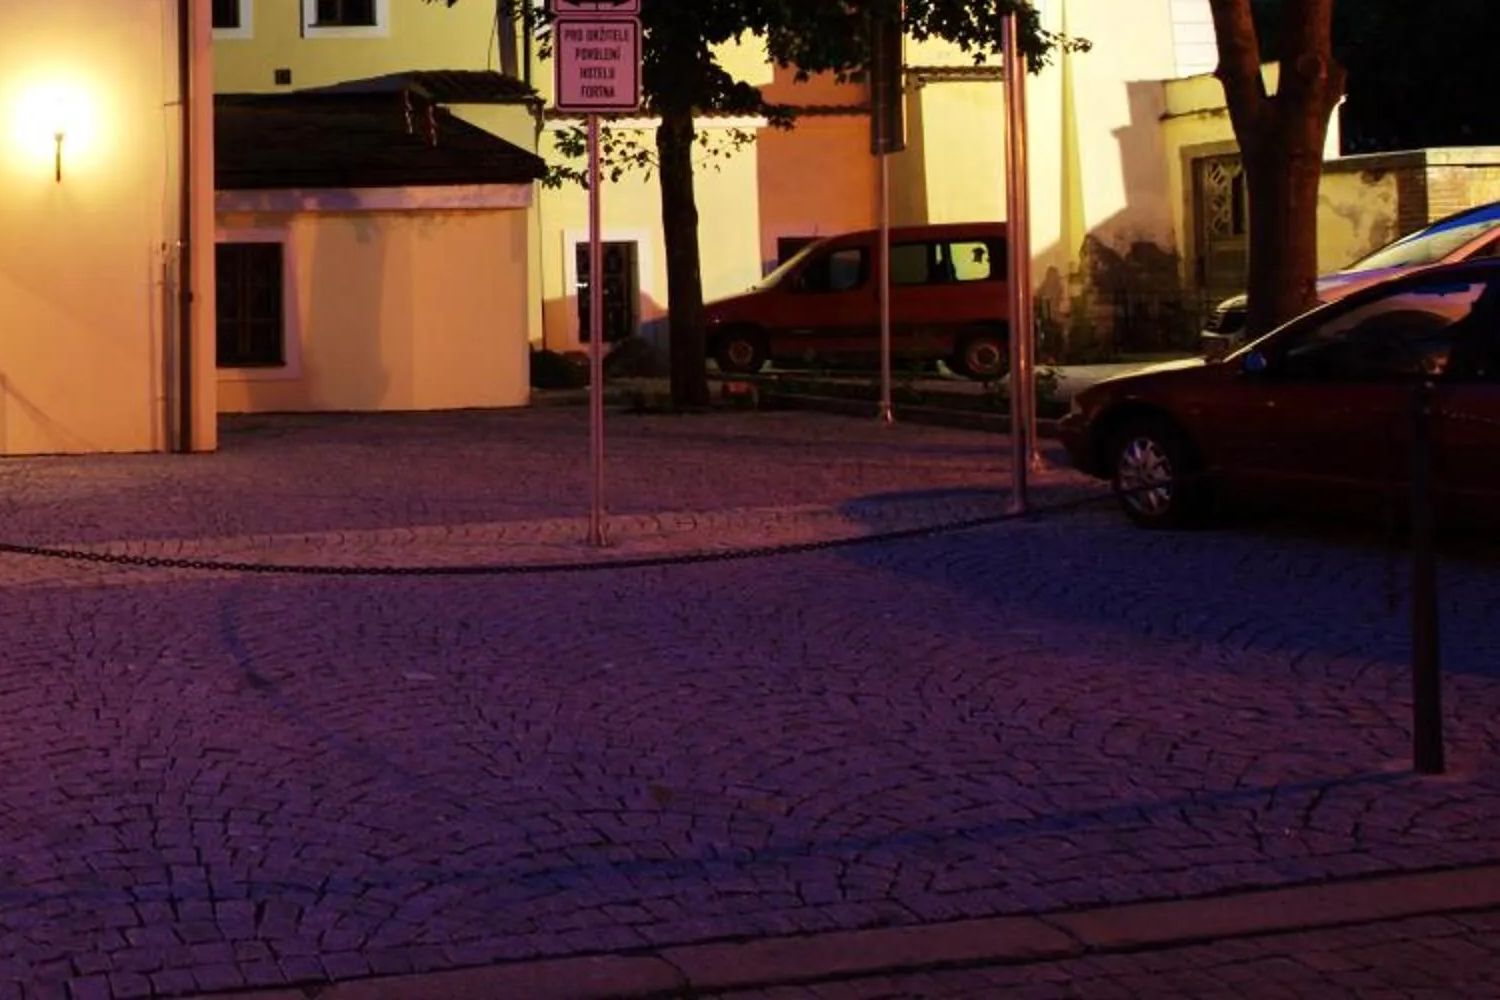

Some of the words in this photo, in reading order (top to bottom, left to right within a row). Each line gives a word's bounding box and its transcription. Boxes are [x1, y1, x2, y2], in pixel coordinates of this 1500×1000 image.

[564, 28, 583, 42] PRO
[580, 66, 615, 79] HOTELU
[580, 85, 615, 98] FORTNA
